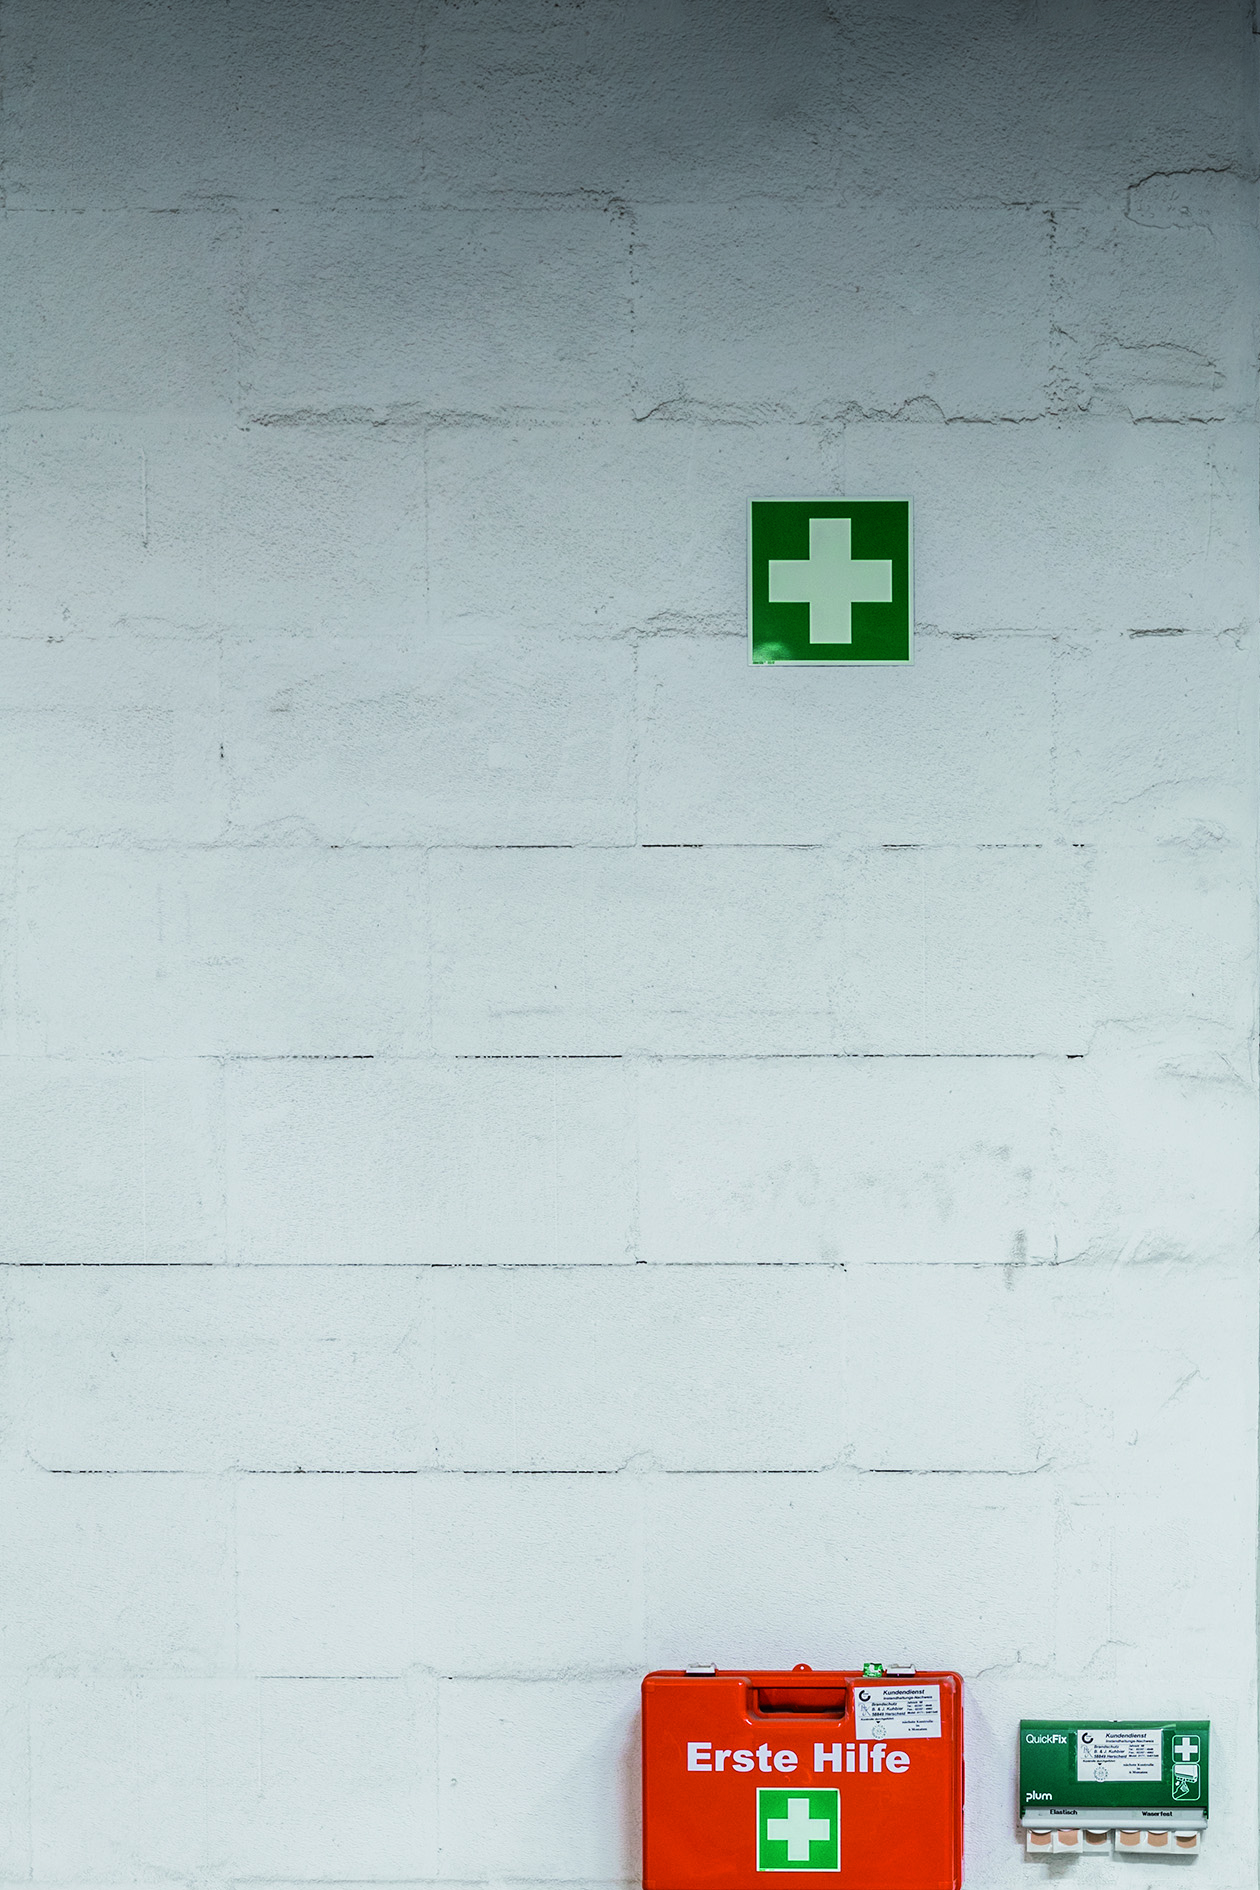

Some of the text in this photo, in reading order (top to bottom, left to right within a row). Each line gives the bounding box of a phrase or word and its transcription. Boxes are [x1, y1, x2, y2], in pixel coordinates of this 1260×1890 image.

[1025, 1733, 1067, 1744] QuickFix
[687, 1742, 911, 1773] Erste Hilfe
[1026, 1790, 1053, 1803] plum
[1050, 1808, 1078, 1816] Elastisch
